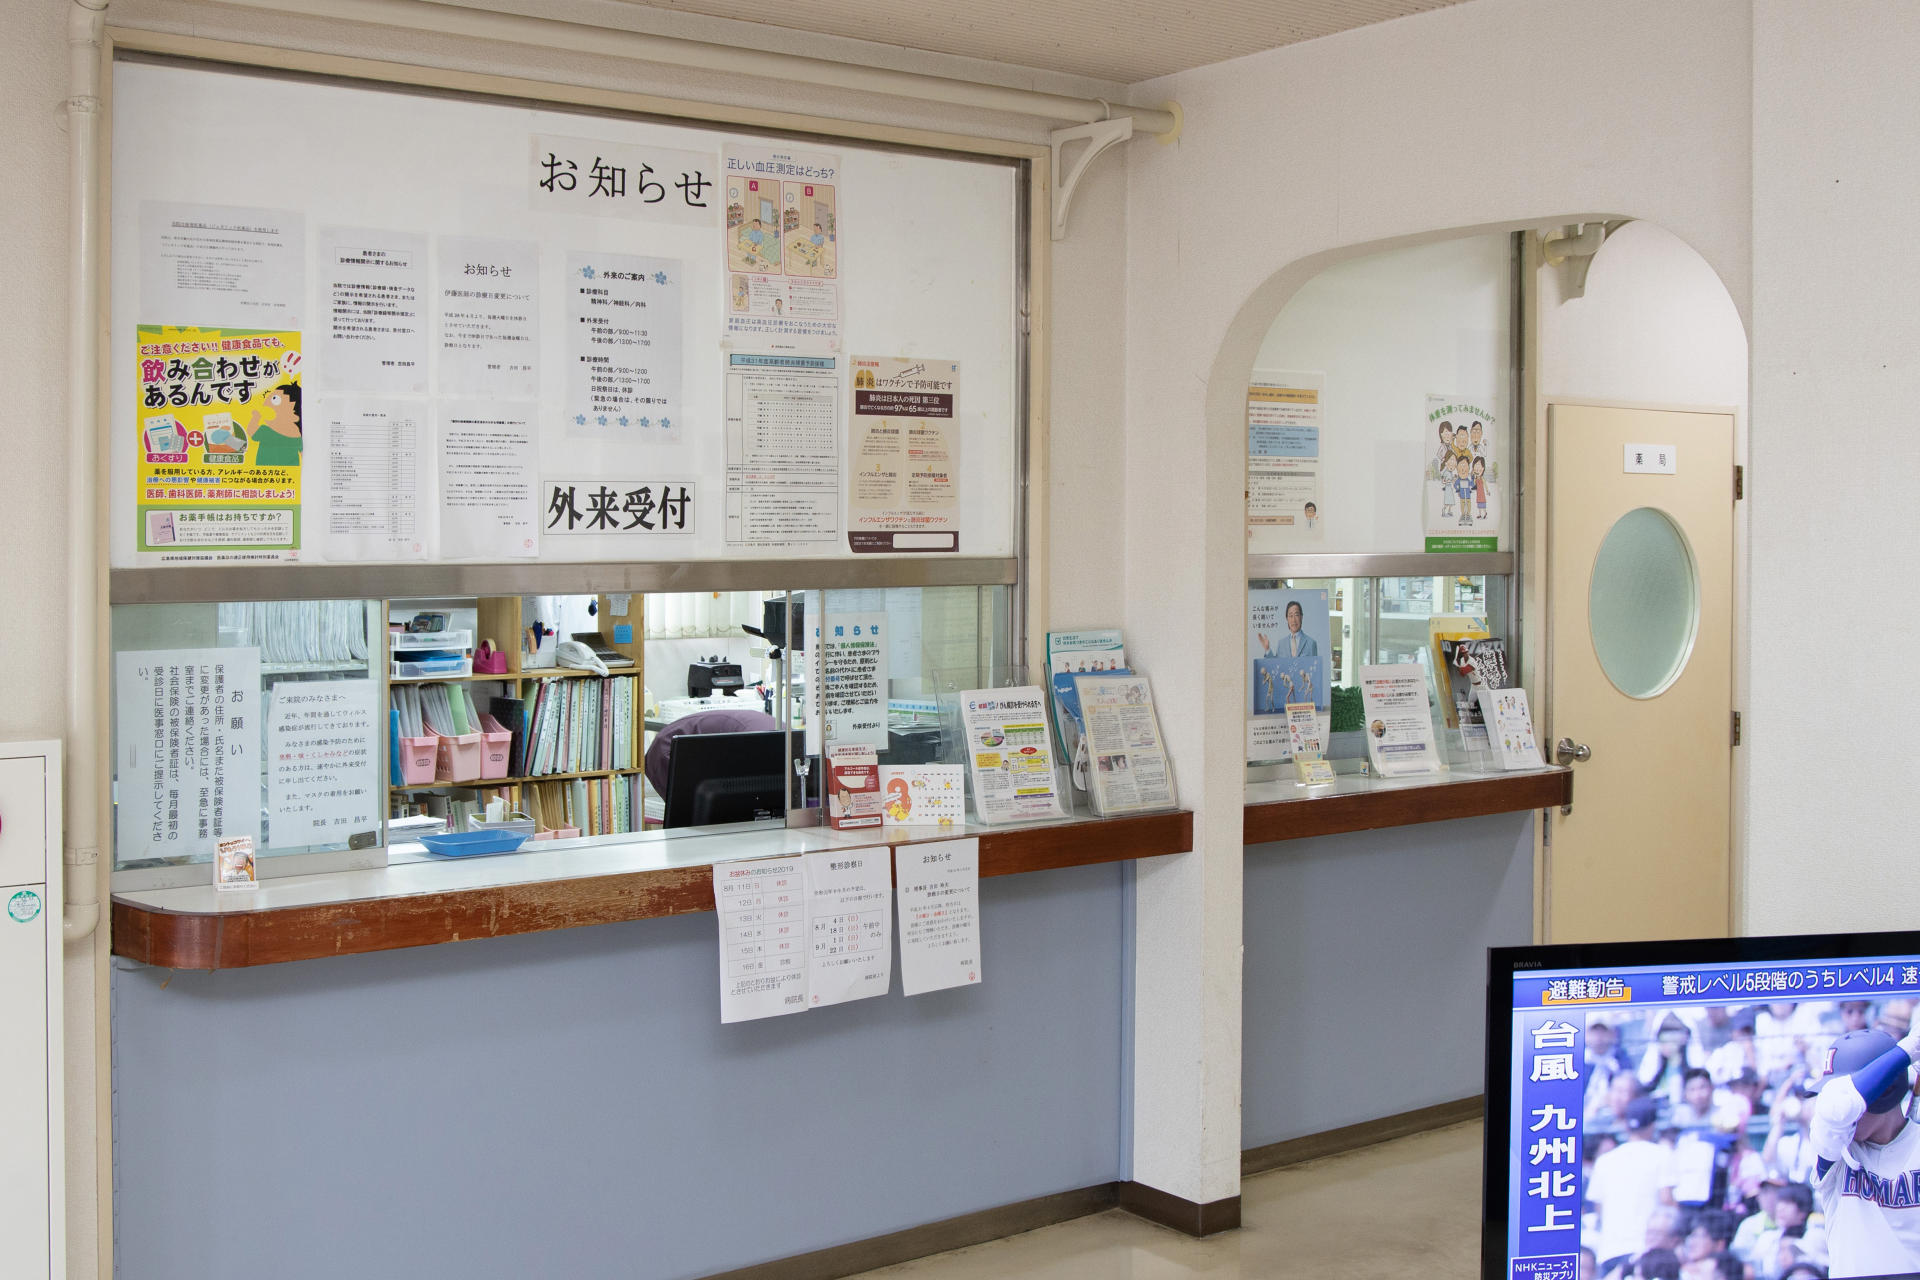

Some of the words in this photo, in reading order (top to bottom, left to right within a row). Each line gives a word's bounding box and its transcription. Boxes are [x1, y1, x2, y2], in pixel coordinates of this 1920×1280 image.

[727, 157, 835, 179] 正しい血圧測定はどっち?
[539, 152, 713, 208] お知らせ
[464, 263, 512, 278] お知らせ
[603, 271, 645, 282] 外来のご案内
[586, 317, 609, 325] 外来受付
[141, 355, 280, 383] 飲み合わせが
[144, 380, 256, 408] あるんです
[151, 454, 184, 463] おくすり
[208, 454, 240, 463] 健康食品
[547, 485, 691, 530] 外来受付
[184, 665, 195, 770] 室までご連絡ください。
[230, 690, 244, 756] お願い
[922, 853, 952, 864] お知らせ
[729, 866, 794, 878] お盆休みのお知らせ2019
[1513, 961, 1542, 969] BRAVIA
[1547, 976, 1625, 1001] 避難勧告
[1662, 966, 1894, 996] 警戒レベル5段階のうちレベル4
[1901, 966, 1920, 985] 速
[1529, 1020, 1581, 1083] 台風
[1527, 1104, 1578, 1232] 九州北上
[1515, 1260, 1574, 1273] NHKニュース・
[1534, 1270, 1574, 1280] 防災アプリ
